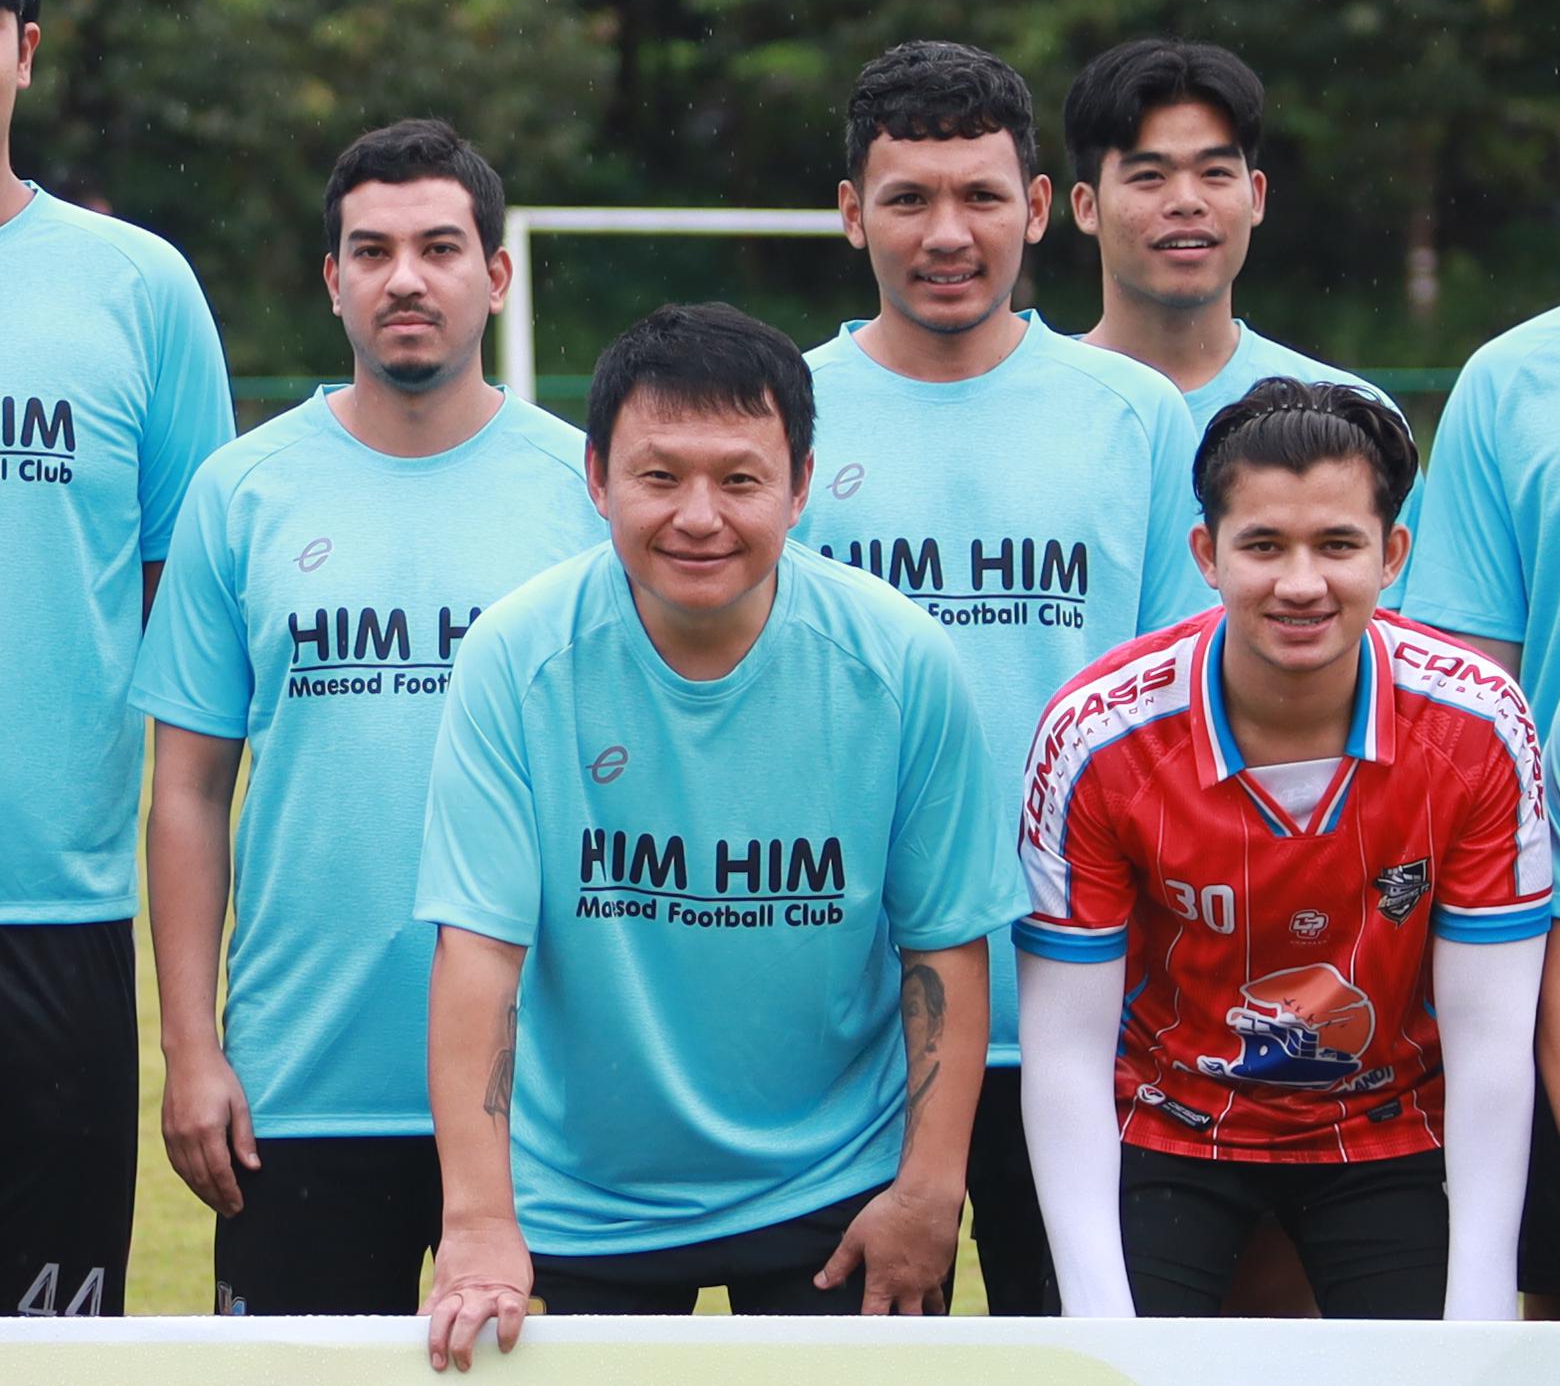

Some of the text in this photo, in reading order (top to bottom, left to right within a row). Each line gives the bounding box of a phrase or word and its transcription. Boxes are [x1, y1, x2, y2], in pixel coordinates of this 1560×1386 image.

[18, 460, 73, 485] Club
[972, 537, 1087, 596] HIM
[288, 607, 410, 664] HIM
[1038, 604, 1084, 629] Club
[289, 672, 382, 698] Maesod
[581, 828, 845, 894] HIM HIM
[668, 902, 773, 928] Football
[785, 902, 843, 926] Club
[1165, 879, 1235, 935] 30
